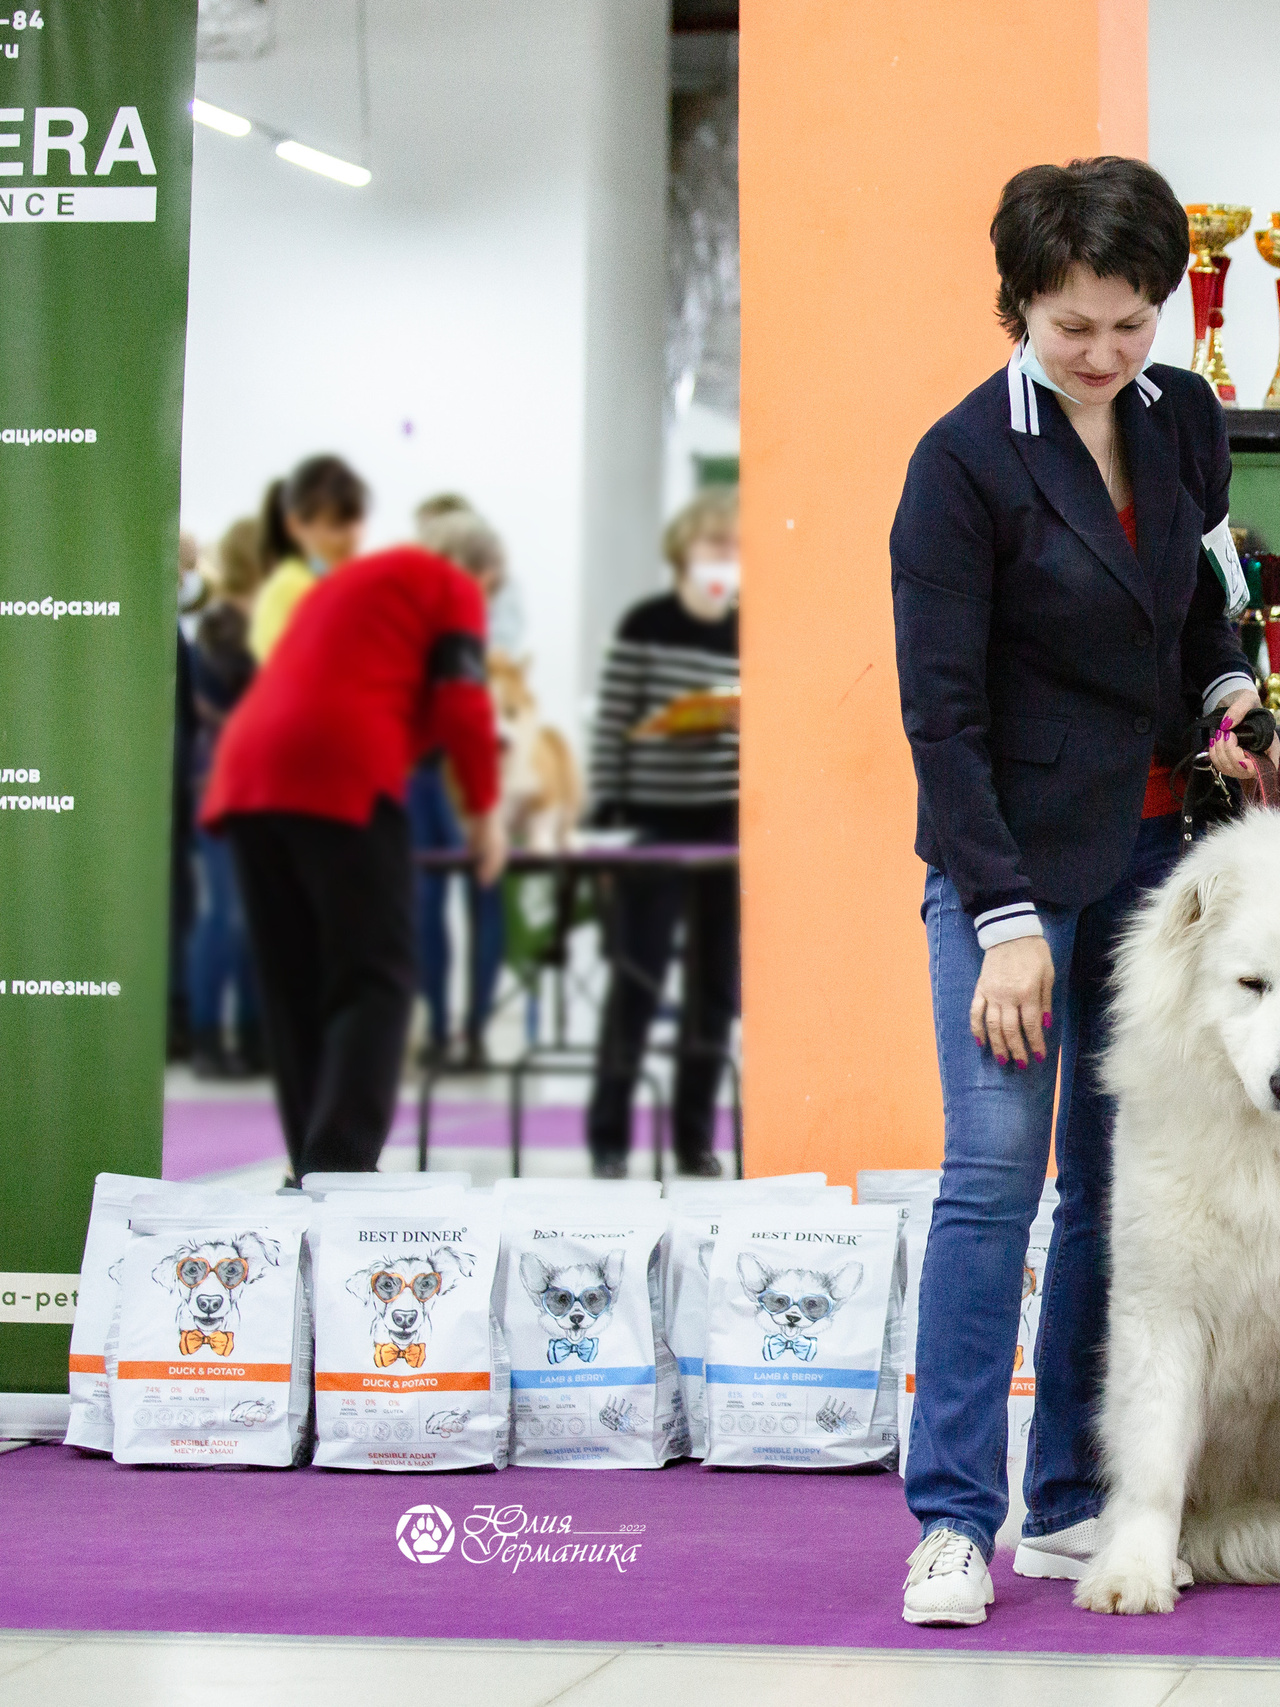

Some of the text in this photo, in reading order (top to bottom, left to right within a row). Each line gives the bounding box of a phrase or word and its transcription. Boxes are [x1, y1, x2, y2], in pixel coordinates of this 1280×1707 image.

[0, 428, 98, 447] ационов
[0, 595, 120, 620] нообразия
[0, 768, 40, 784] лов
[12, 980, 121, 996] полезные
[359, 1230, 463, 1242] BEST DINNER
[751, 1231, 858, 1246] BEST DINNER
[168, 1366, 246, 1377] DUCK & POTATO
[753, 1372, 780, 1381] LAMB
[792, 1373, 824, 1382] BERRY
[362, 1378, 438, 1389] DUCK & POTATO
[540, 1373, 605, 1383] LAMB & BERRY
[170, 1439, 209, 1447] SENSIBLE
[409, 1452, 437, 1460] ADULT
[752, 1446, 821, 1455] SENSIBLE PUPPY
